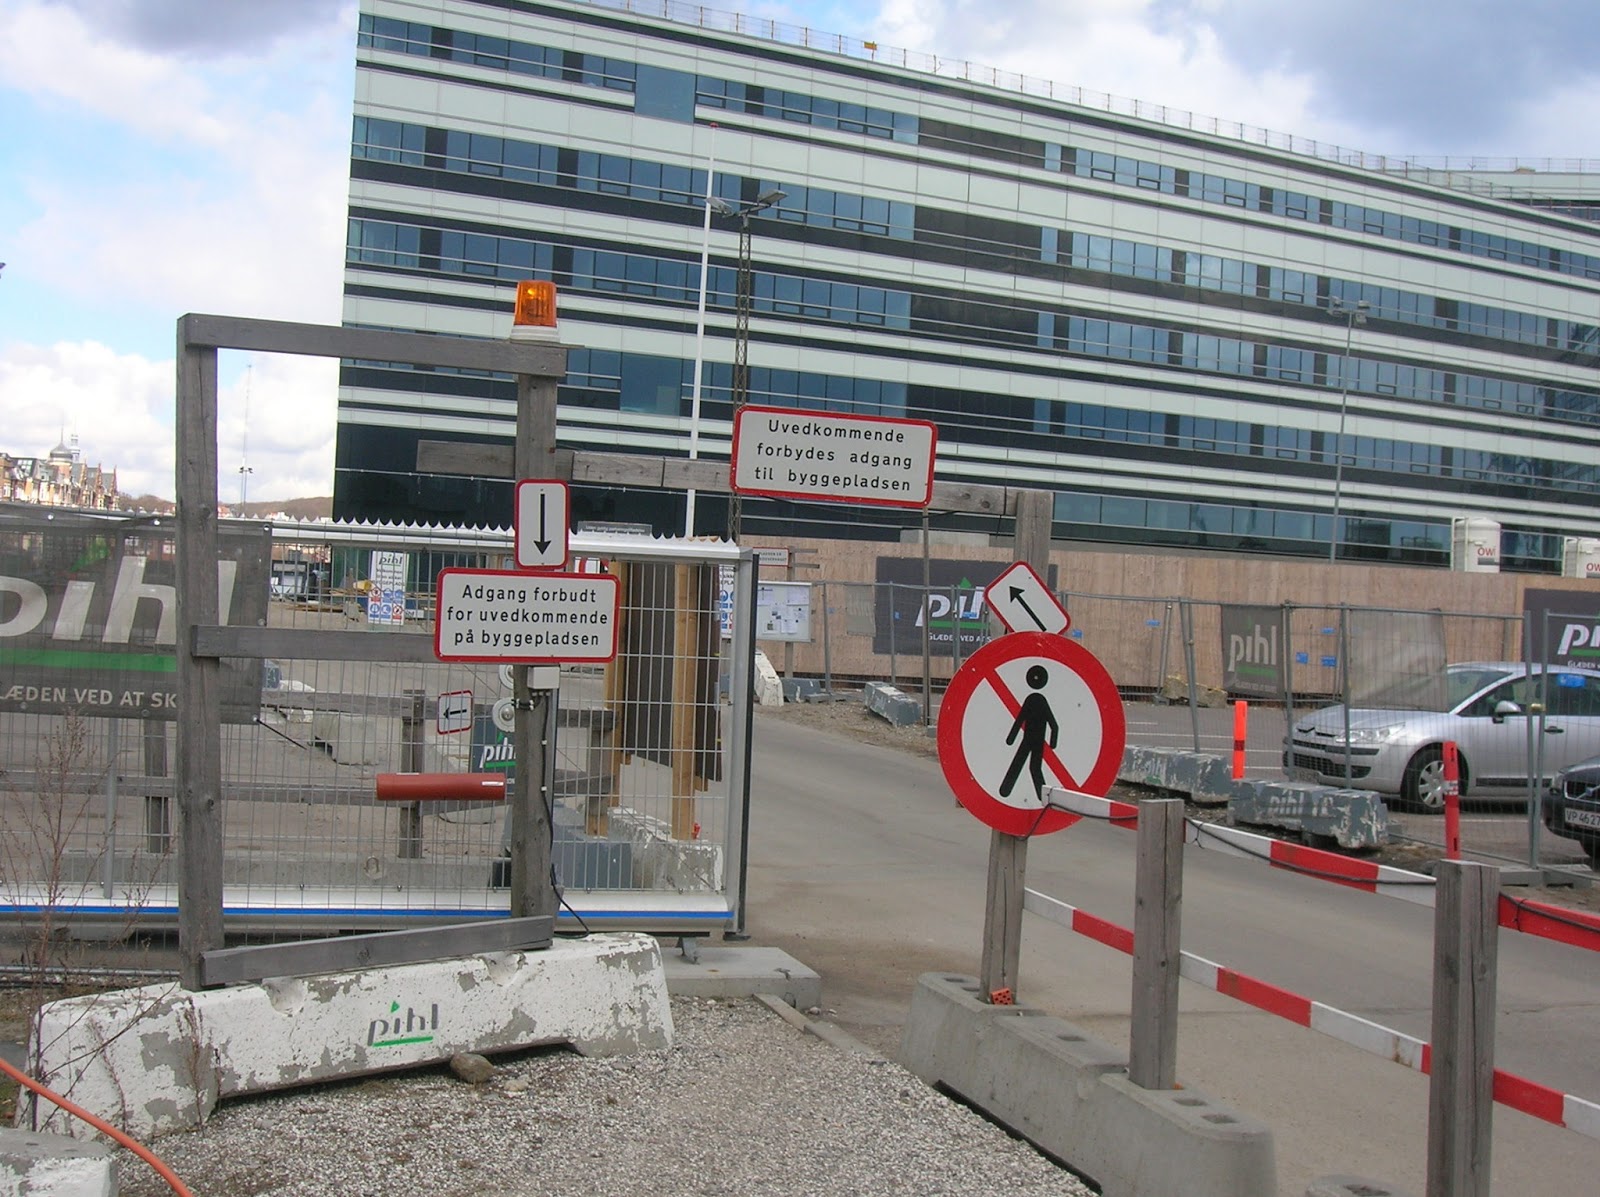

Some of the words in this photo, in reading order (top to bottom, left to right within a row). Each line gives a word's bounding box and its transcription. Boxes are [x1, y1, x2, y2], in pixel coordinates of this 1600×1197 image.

[768, 419, 904, 443] Uvedkommende
[757, 443, 835, 461] forbydes
[850, 450, 912, 470] adgang
[755, 466, 774, 480] til
[788, 469, 910, 491] byggepladsen
[379, 554, 402, 565] pihl
[462, 584, 526, 602] Adgang
[534, 587, 596, 602] forbudt
[447, 607, 473, 621] for
[480, 608, 608, 624] uvedkommende
[454, 629, 474, 646] på
[482, 630, 599, 646] byggepladsen
[1227, 624, 1277, 672] pihl
[73, 688, 112, 704] VED
[120, 691, 144, 706] AT
[479, 737, 516, 768] pih
[367, 1001, 438, 1047] pihl
